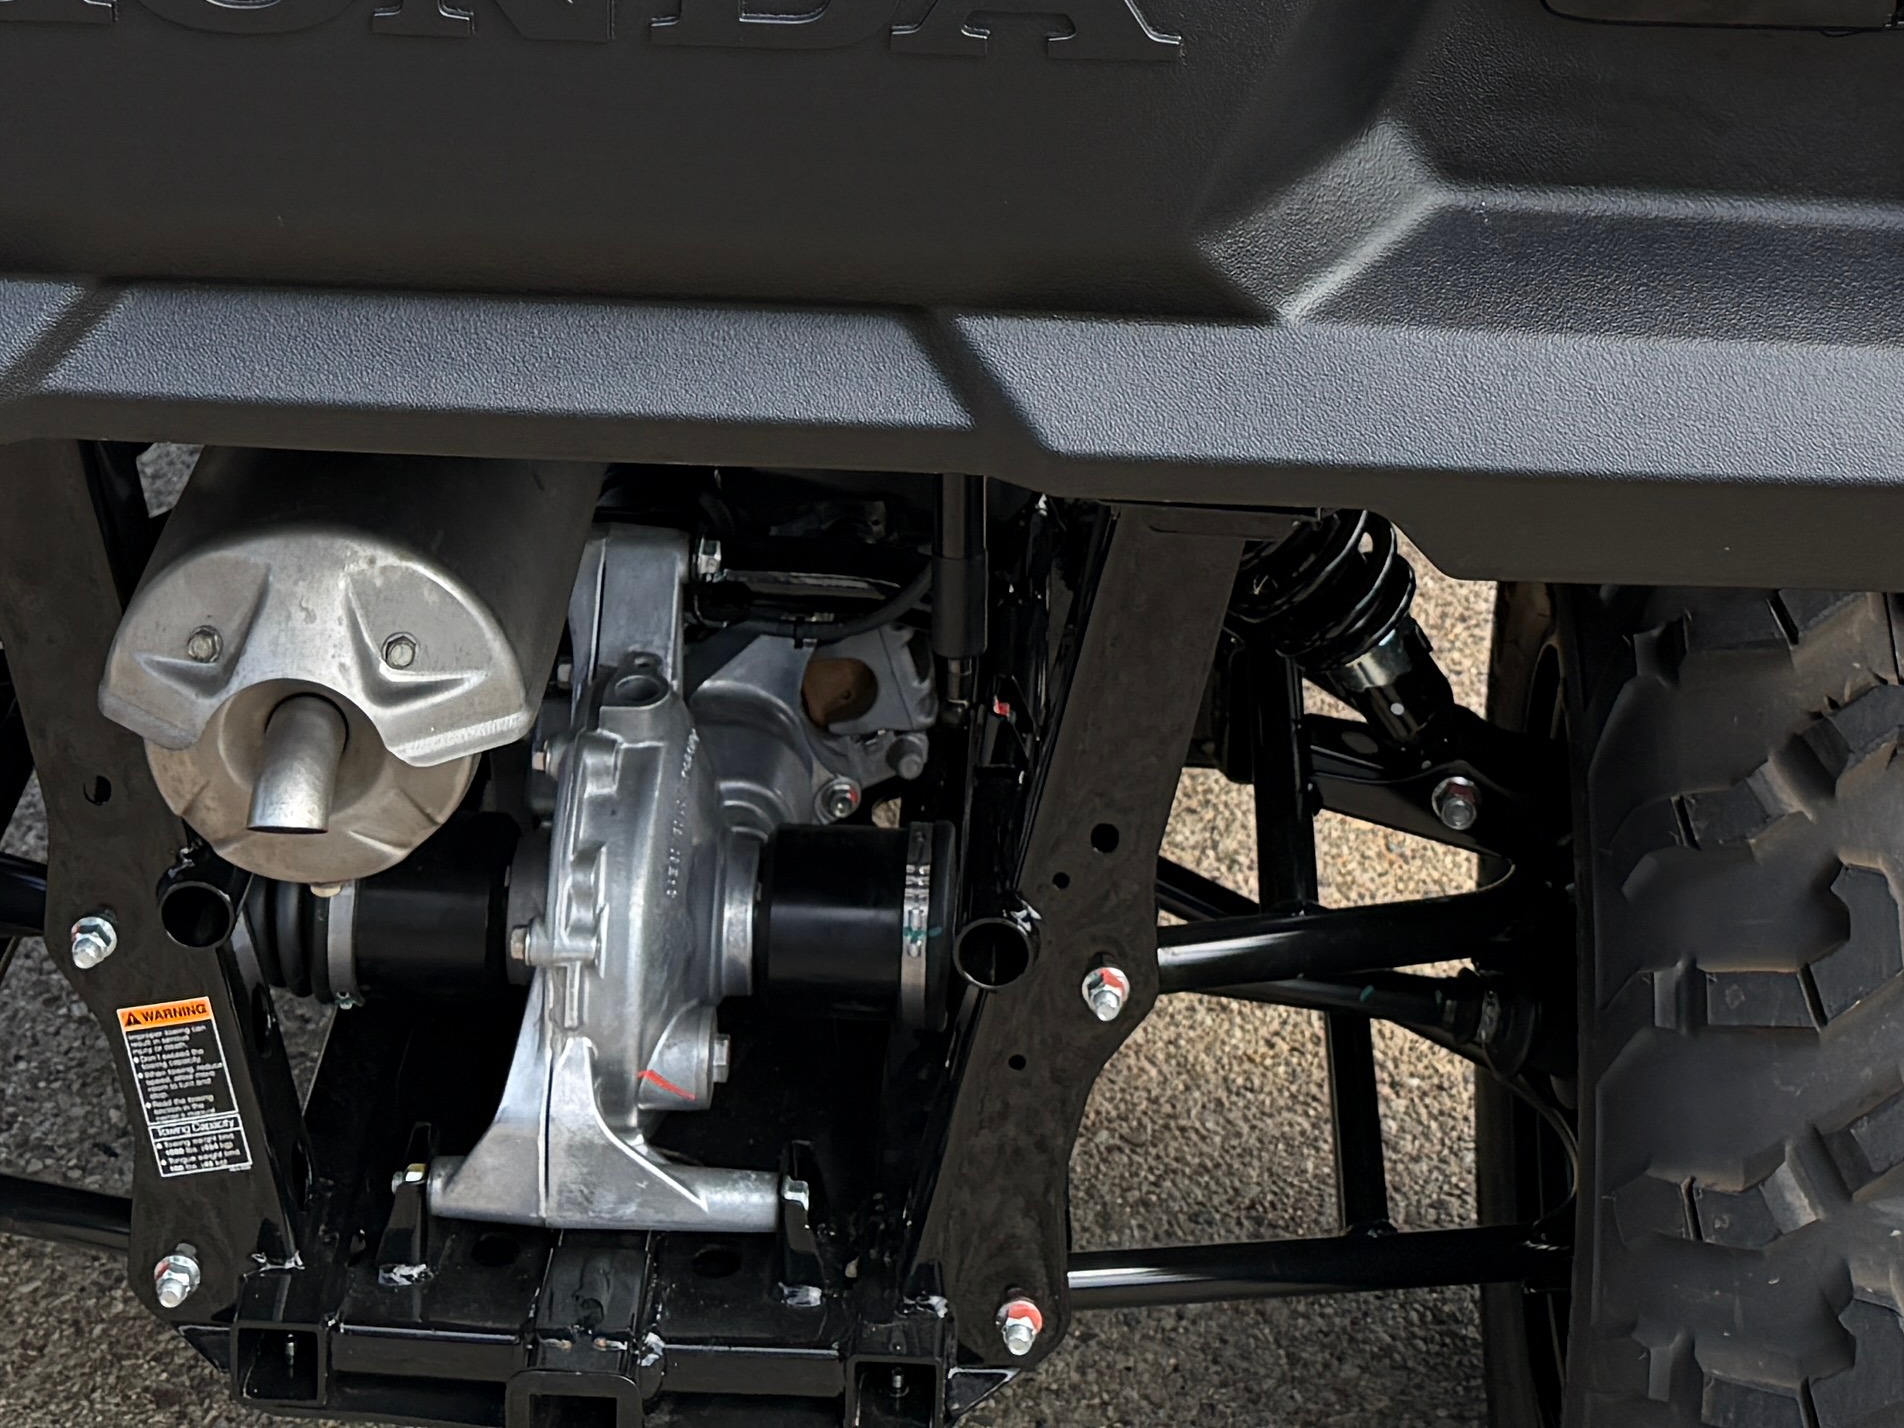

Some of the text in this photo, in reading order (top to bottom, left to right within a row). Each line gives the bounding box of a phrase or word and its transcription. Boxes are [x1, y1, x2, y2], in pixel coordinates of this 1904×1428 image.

[140, 1003, 207, 1022] WARNING
[157, 1119, 235, 1137] Towing Capacity
